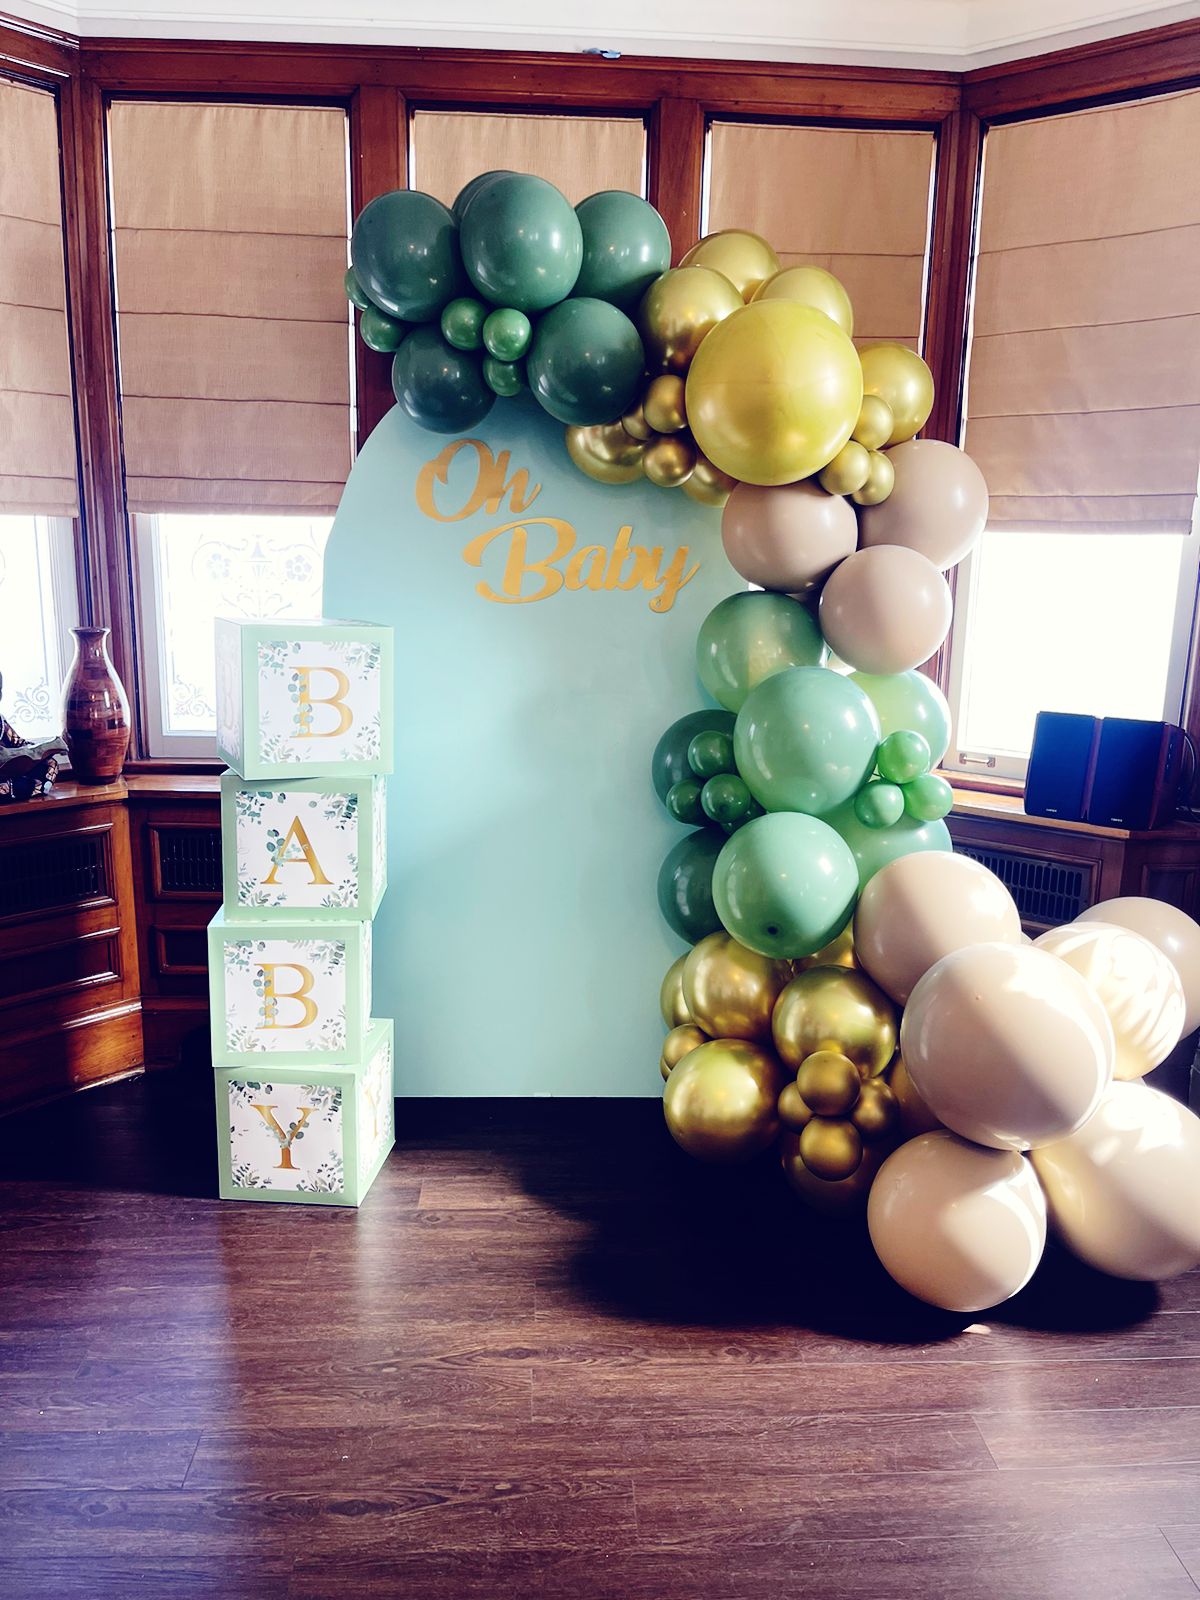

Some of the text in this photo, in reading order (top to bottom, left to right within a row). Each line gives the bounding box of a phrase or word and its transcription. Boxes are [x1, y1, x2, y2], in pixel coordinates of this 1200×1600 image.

[415, 438, 542, 523] Oh
[462, 517, 700, 613] Baby
[289, 666, 354, 738] B
[260, 815, 335, 885] A
[253, 963, 319, 1030] B
[250, 1104, 320, 1170] Y
